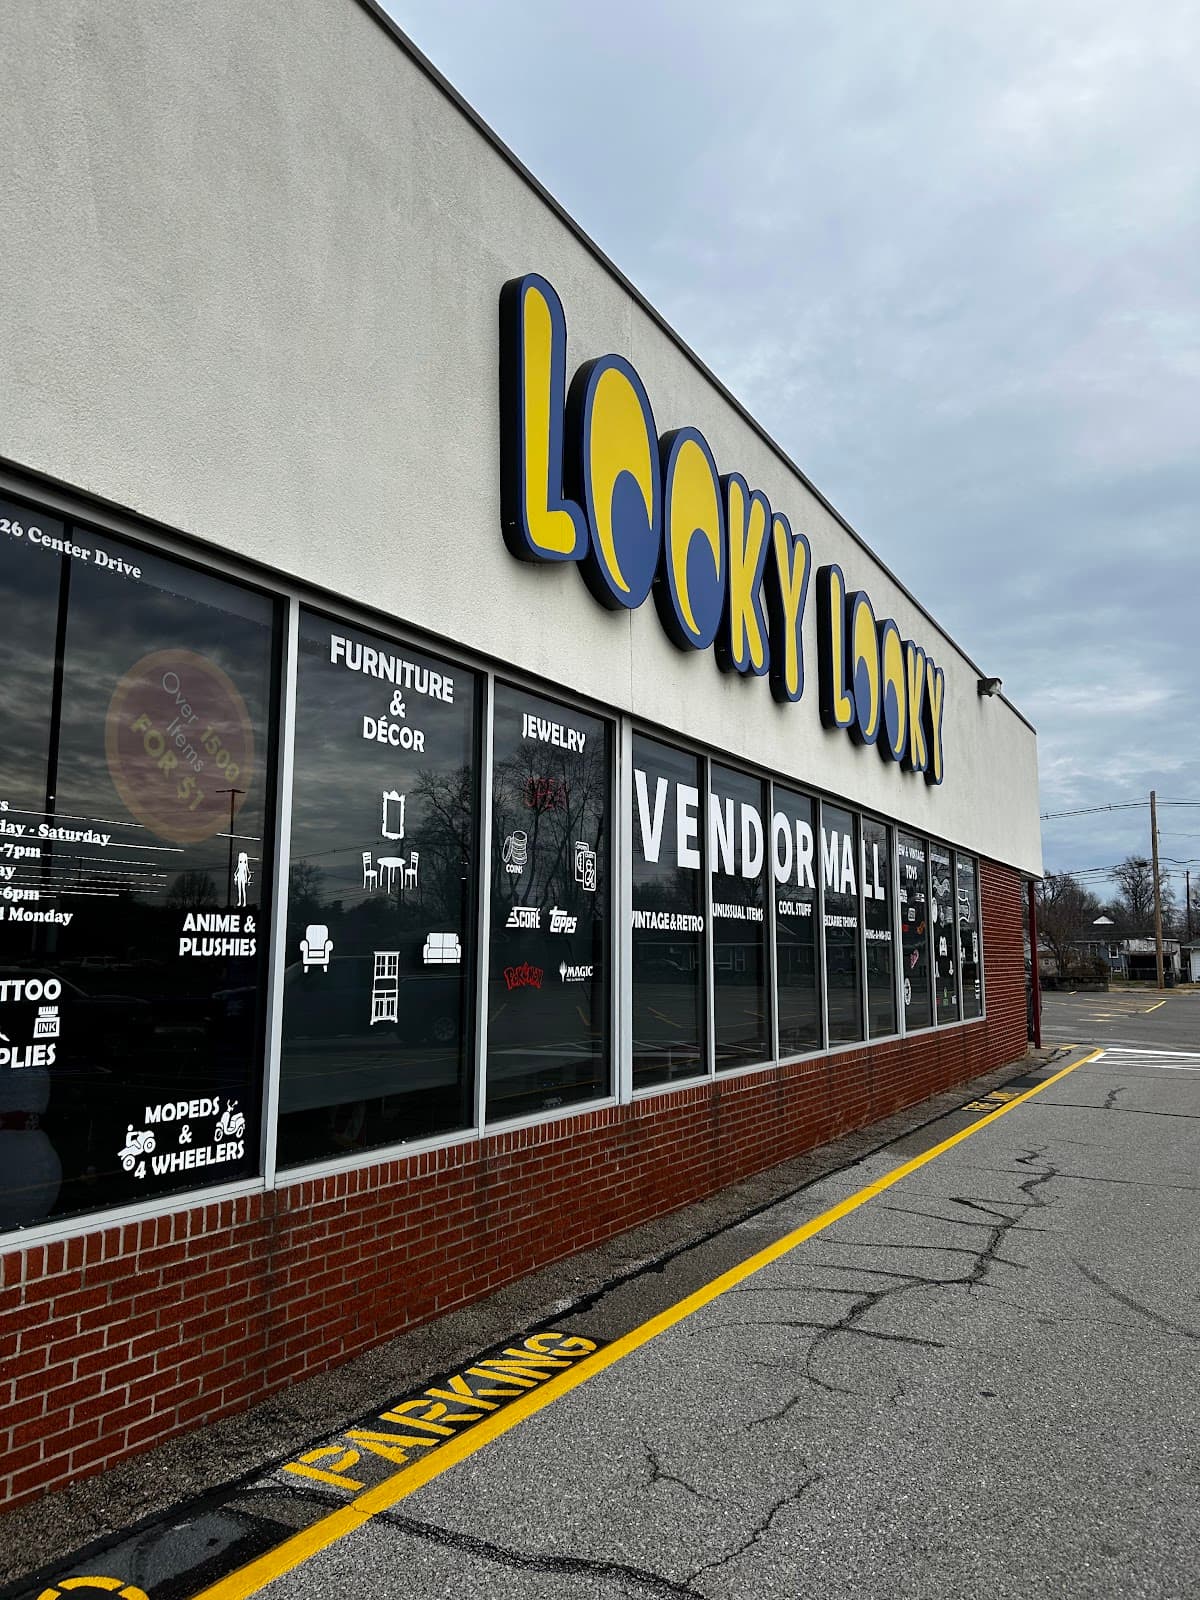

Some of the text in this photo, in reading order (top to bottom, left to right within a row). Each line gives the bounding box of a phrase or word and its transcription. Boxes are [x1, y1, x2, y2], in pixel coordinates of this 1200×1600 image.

[500, 272, 945, 786] LOOKY LOOKY
[28, 526, 91, 560] Center
[94, 549, 142, 578] Drive
[330, 634, 454, 704] FURNITURE
[389, 689, 406, 718] &
[162, 671, 240, 782] Over 1500
[363, 715, 425, 752] DÉCOR
[522, 713, 586, 753] JEWELRY
[130, 713, 178, 780] FOR
[166, 717, 205, 772] Items
[38, 823, 111, 846] Saturday
[634, 769, 885, 901] VENDOR MALL
[8, 907, 73, 926] Monday
[183, 912, 256, 933] ANIME &
[505, 906, 540, 928] SCORE
[746, 906, 764, 922] ITEMS
[778, 900, 812, 917] COOL STUFF
[179, 937, 256, 957] PLUSHIES
[566, 966, 594, 978] MAGIC
[39, 1022, 56, 1033] INK
[145, 1096, 220, 1124] MOPEDS
[178, 1124, 192, 1144] &
[134, 1140, 245, 1179] 4 WHEELERS
[284, 1333, 598, 1490] PARKING
